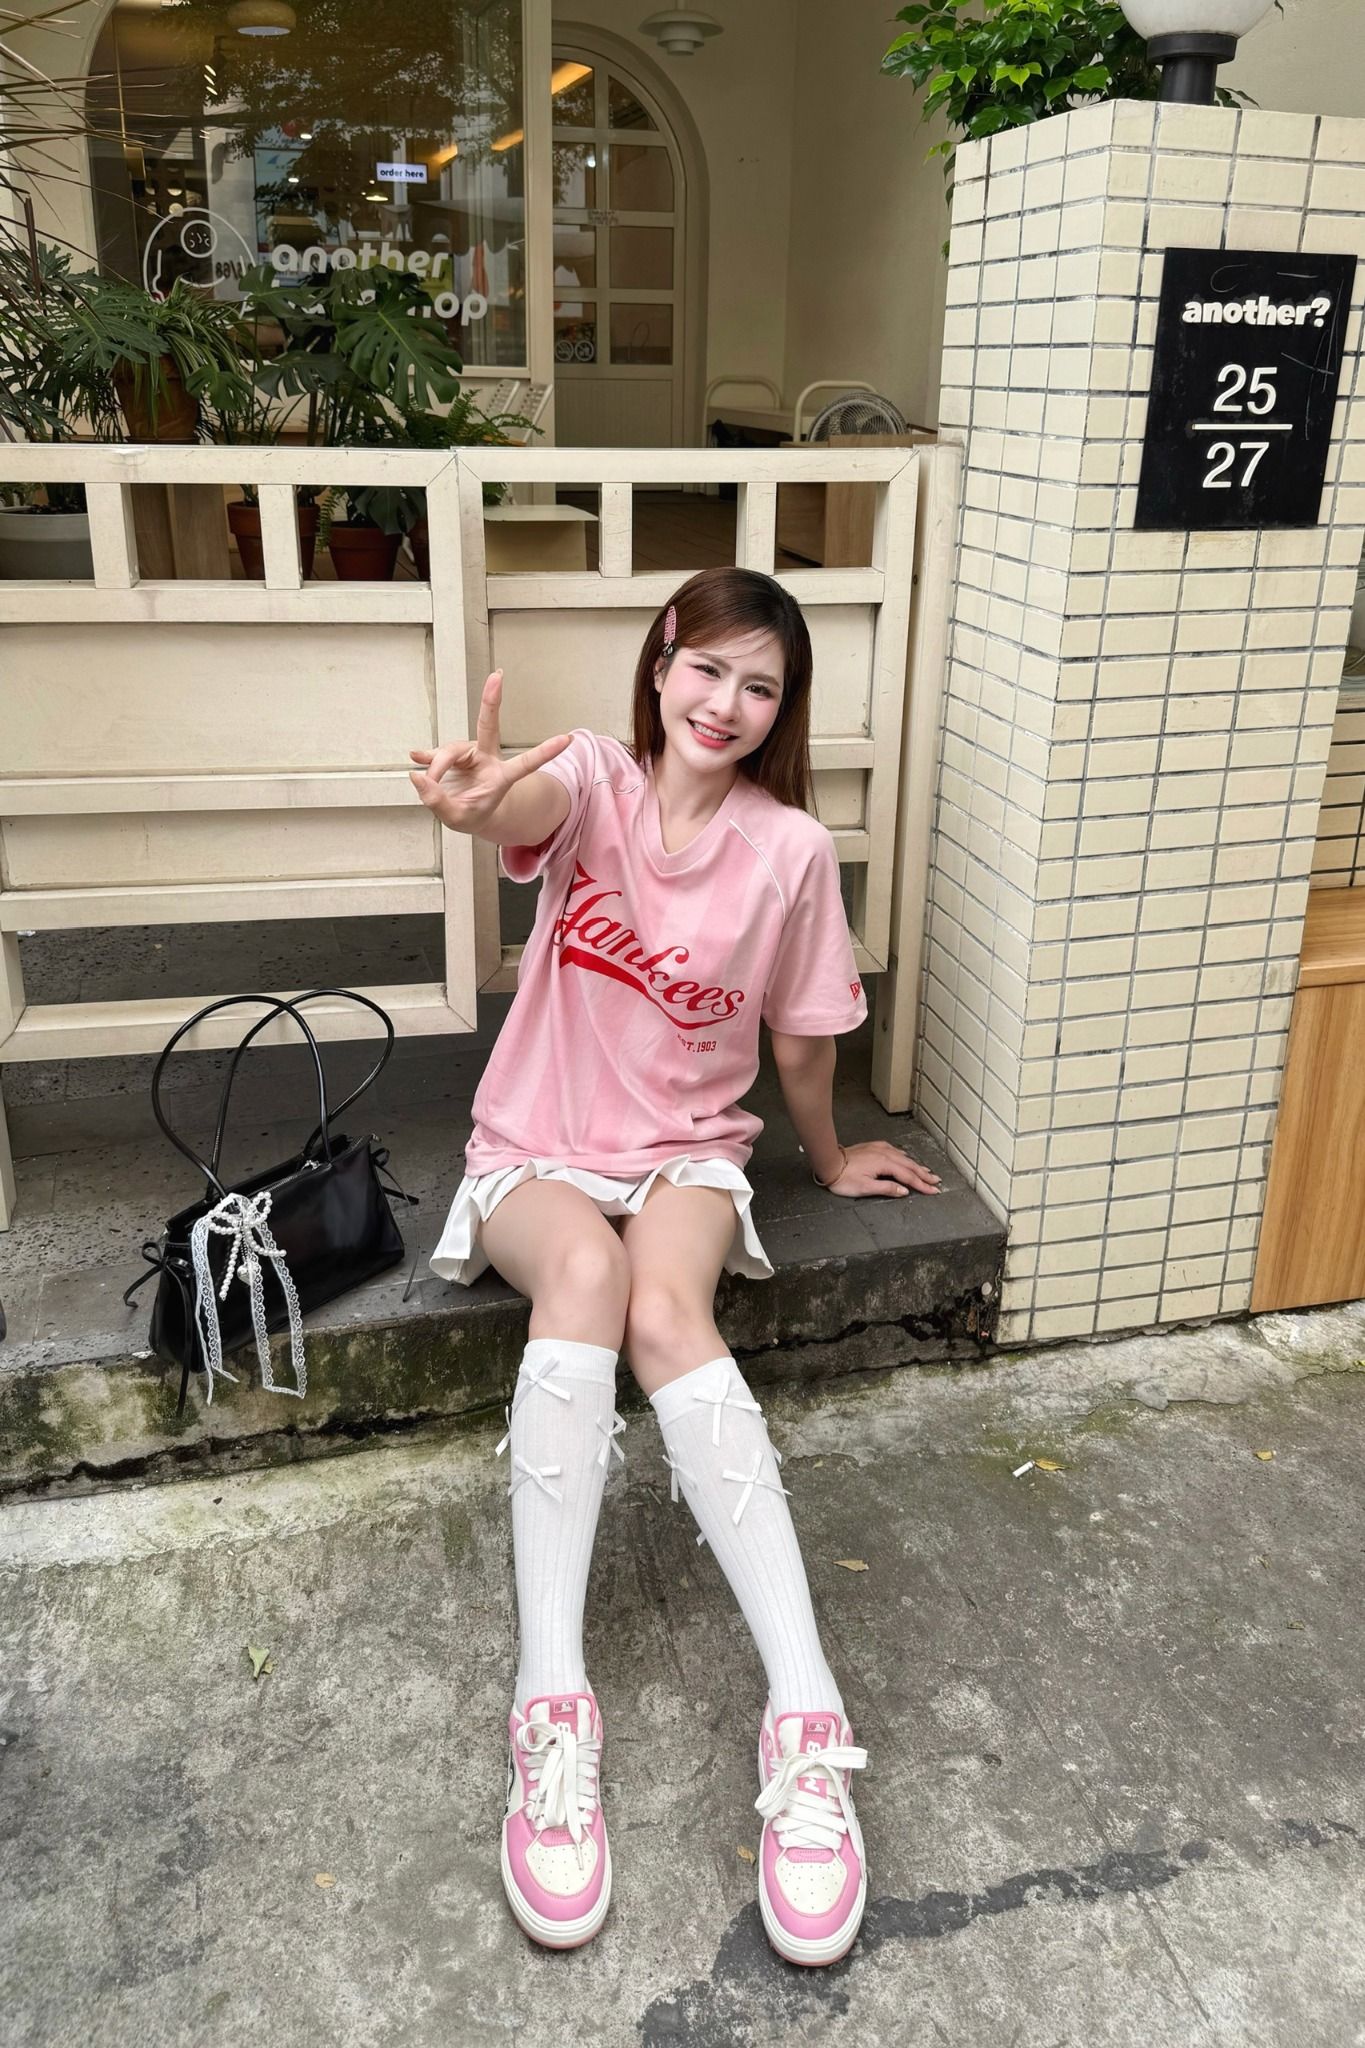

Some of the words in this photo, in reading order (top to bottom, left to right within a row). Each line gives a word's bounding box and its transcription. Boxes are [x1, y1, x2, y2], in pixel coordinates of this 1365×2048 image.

[380, 168, 403, 178] order
[404, 168, 425, 179] here
[271, 241, 449, 279] another
[1182, 296, 1331, 328] another?
[1213, 363, 1278, 416] 25
[1202, 441, 1270, 489] 27
